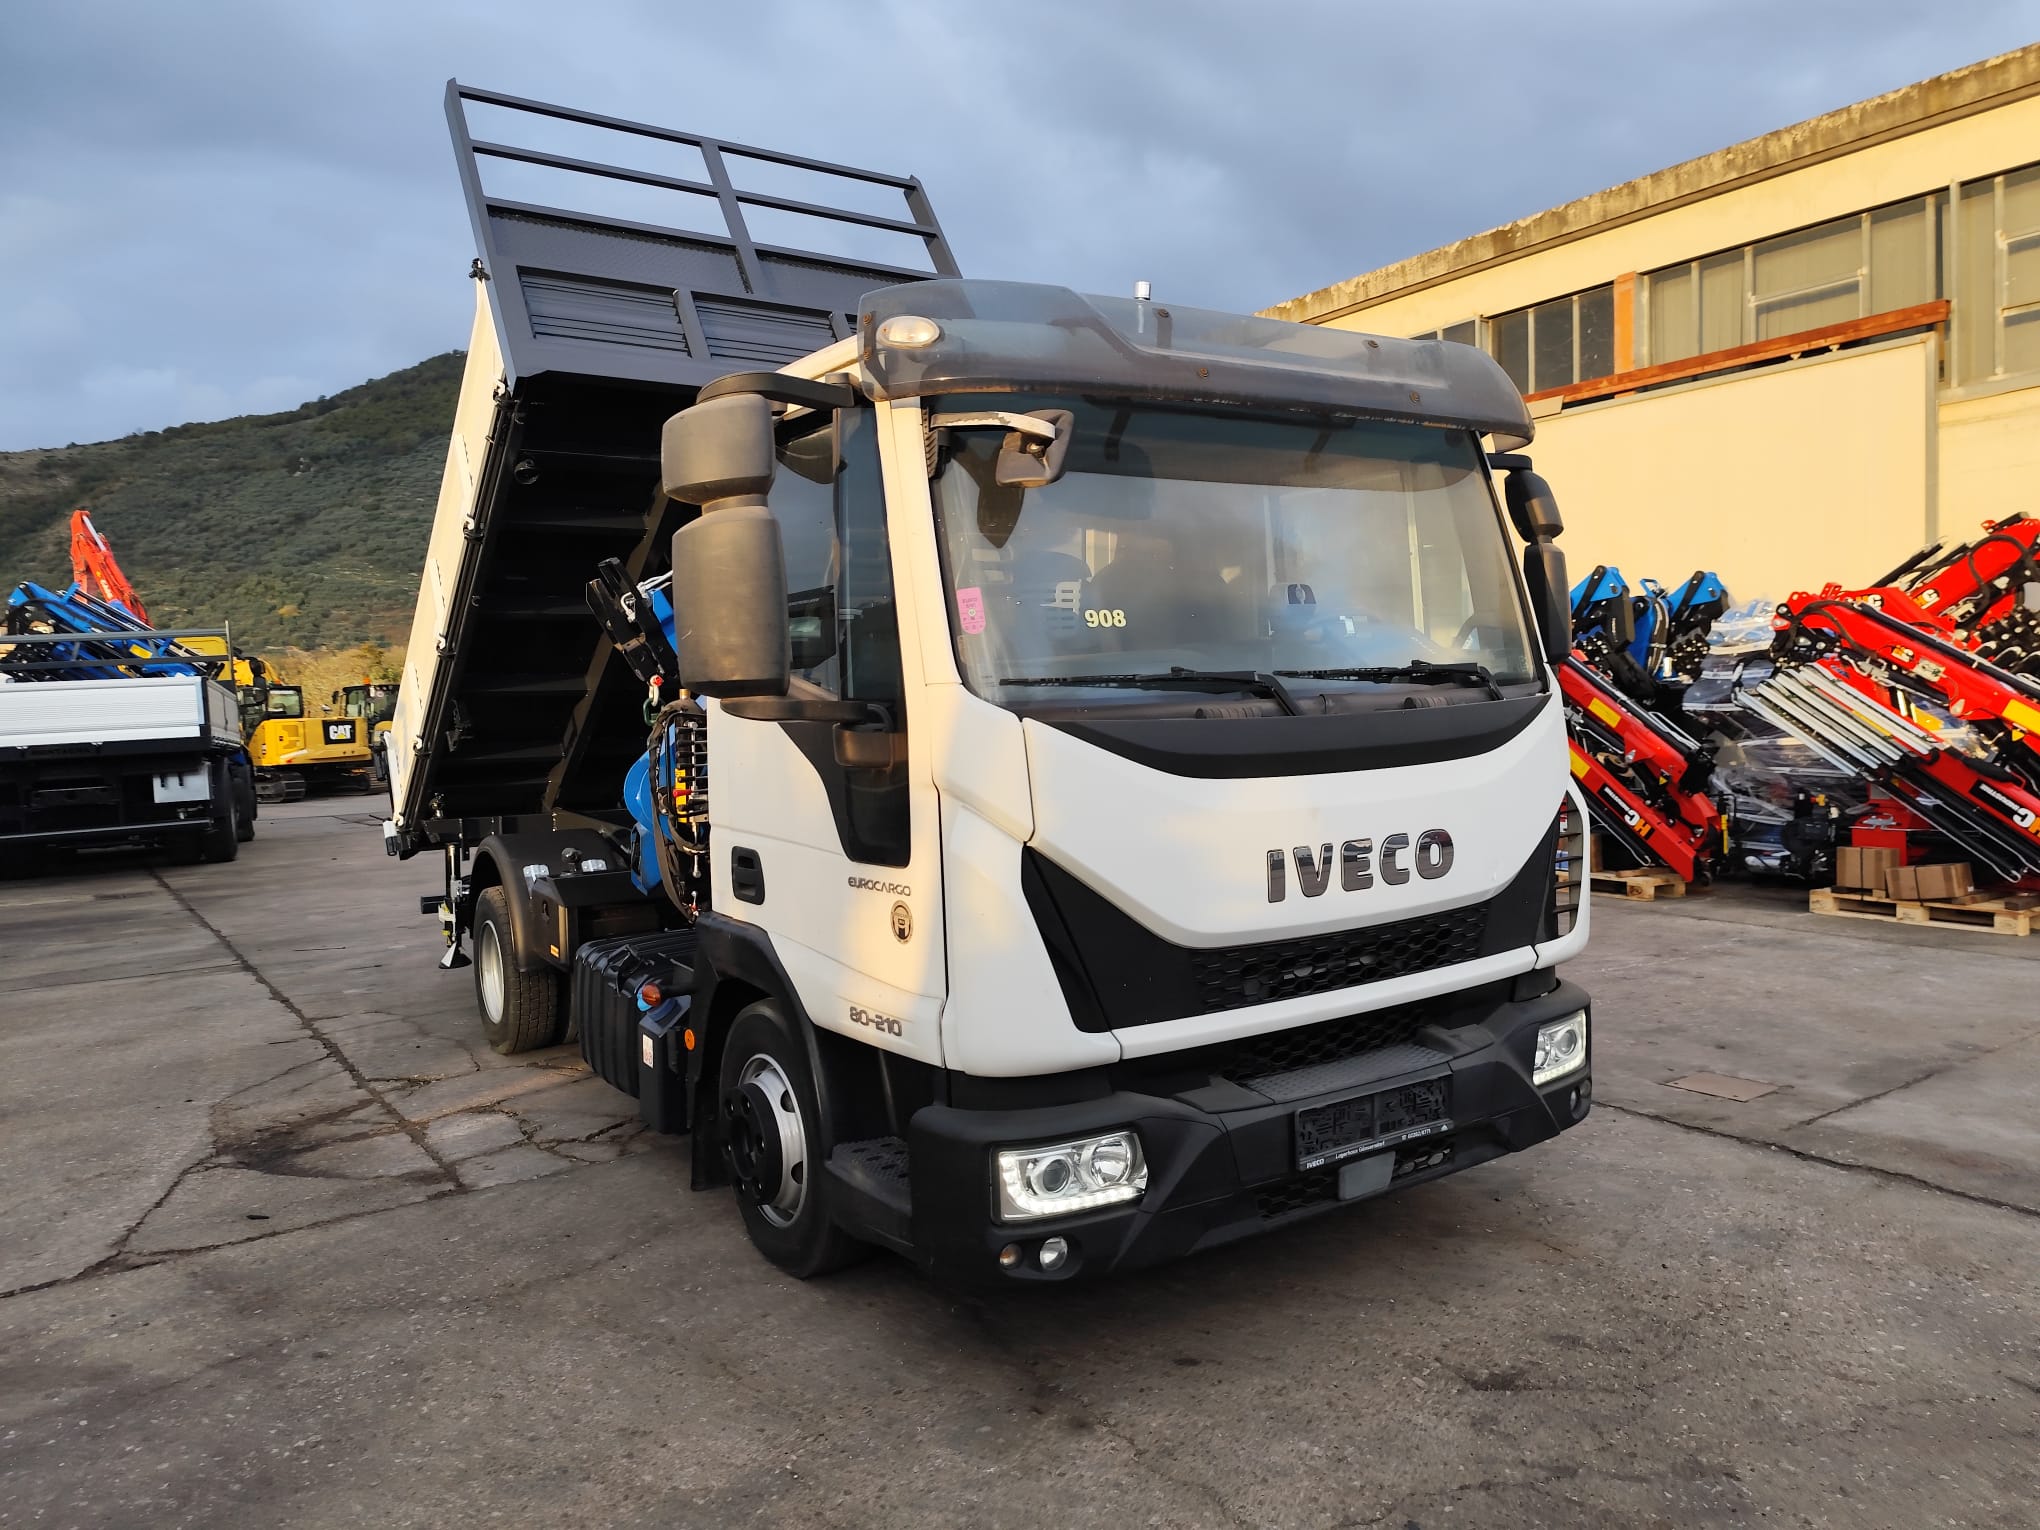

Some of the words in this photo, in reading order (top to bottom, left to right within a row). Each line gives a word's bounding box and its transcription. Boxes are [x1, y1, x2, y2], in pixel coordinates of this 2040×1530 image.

[1084, 609, 1127, 628] 908
[329, 724, 352, 740] CAT
[1624, 809, 1651, 837] HC
[1266, 828, 1455, 903] IVECO
[847, 876, 911, 897] EUROCARGO
[849, 1006, 902, 1037] 80-210
[1306, 1158, 1325, 1169] IVECO
